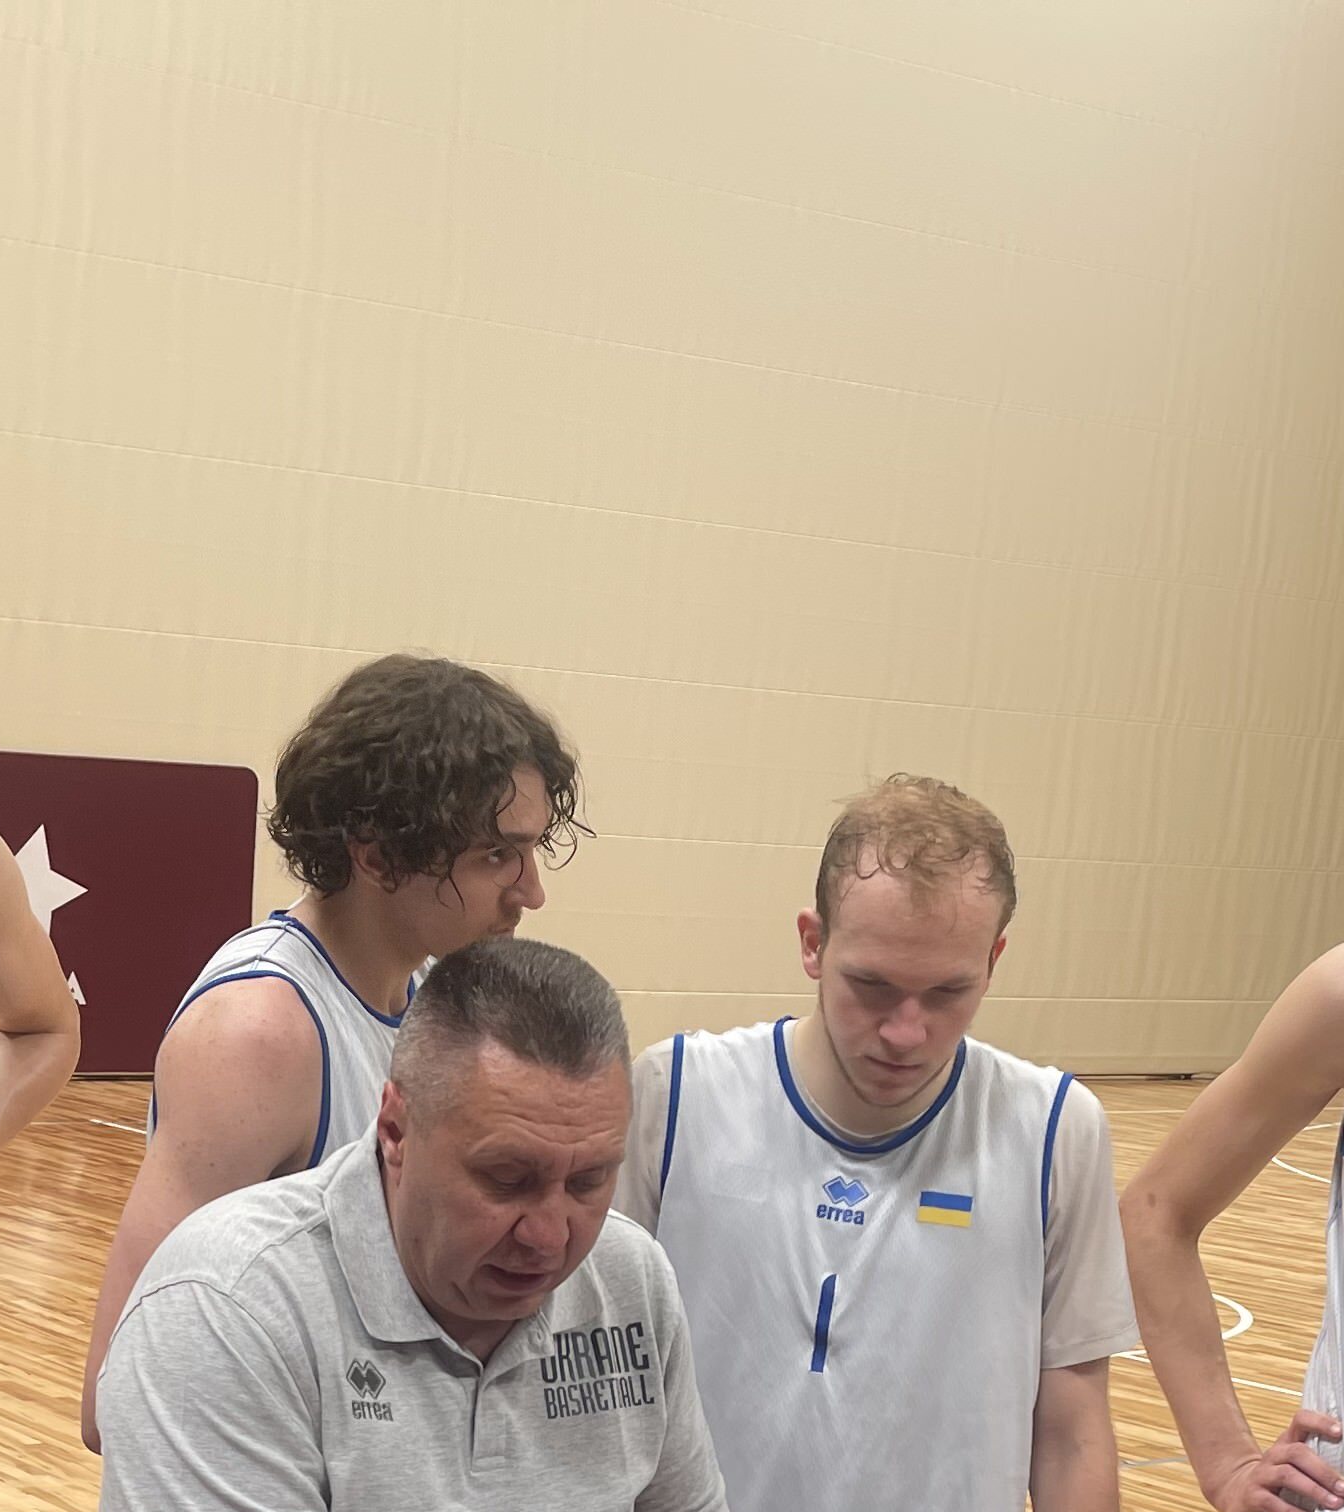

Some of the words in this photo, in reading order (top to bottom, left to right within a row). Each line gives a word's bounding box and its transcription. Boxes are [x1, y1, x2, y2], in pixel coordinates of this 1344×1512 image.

[816, 1204, 865, 1225] errea
[810, 1273, 837, 1373] 1
[540, 1321, 650, 1384] UKRANE
[352, 1400, 394, 1421] errea
[544, 1374, 654, 1419] BASKETALL
